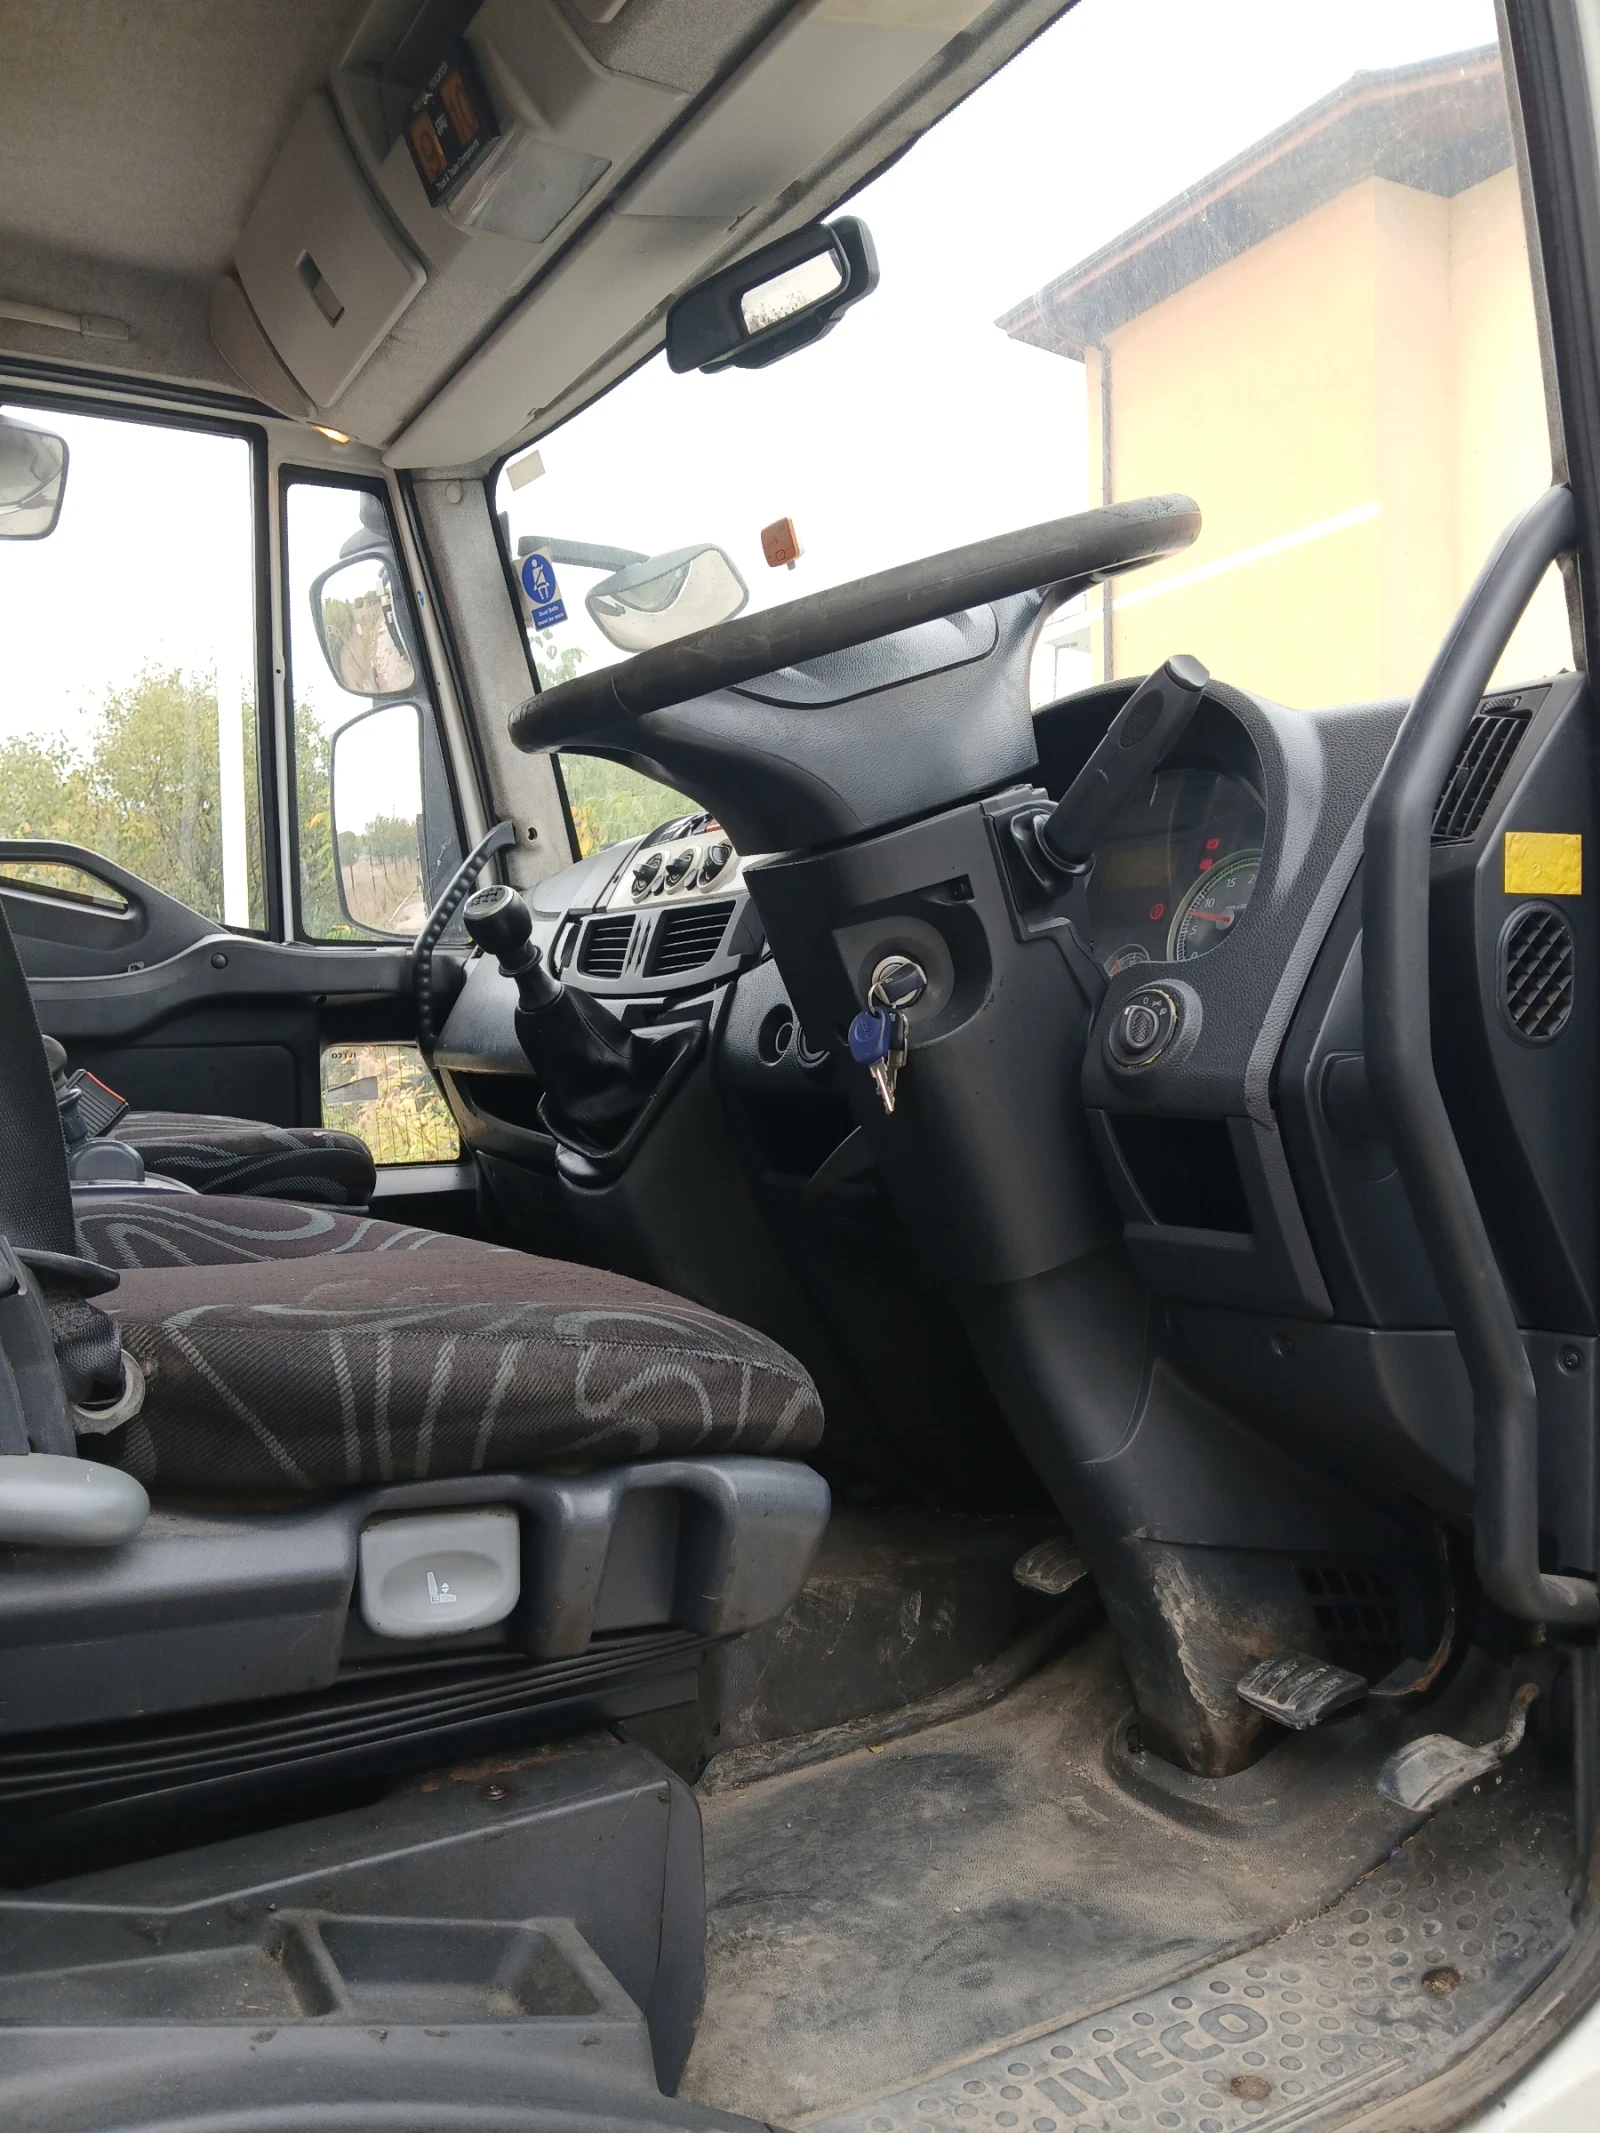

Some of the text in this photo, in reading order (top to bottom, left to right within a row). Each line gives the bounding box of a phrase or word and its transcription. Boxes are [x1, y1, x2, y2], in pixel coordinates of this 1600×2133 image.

[1226, 877, 1237, 888] 15
[1248, 874, 1257, 884] 2
[1204, 898, 1215, 908] 10
[1189, 925, 1198, 936] 5
[1034, 2003, 1269, 2117] IVECO
